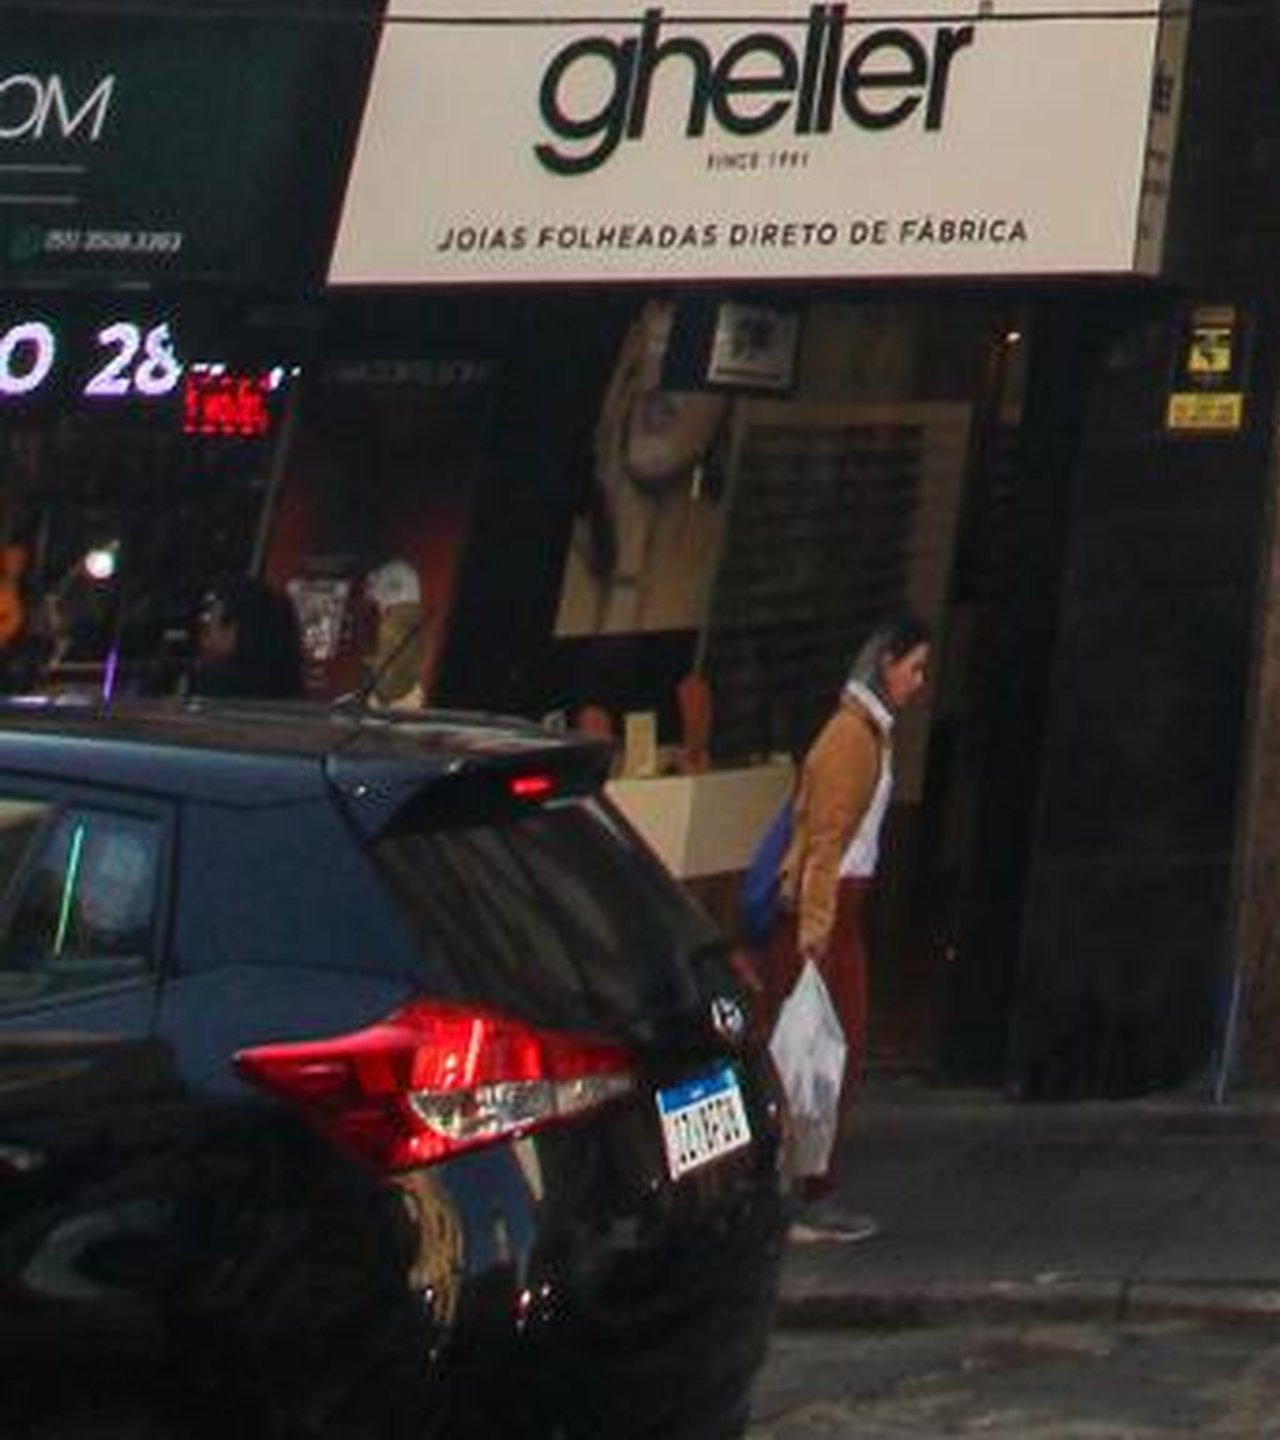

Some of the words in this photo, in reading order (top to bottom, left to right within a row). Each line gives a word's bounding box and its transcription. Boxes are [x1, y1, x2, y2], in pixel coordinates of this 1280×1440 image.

[532, 3, 974, 177] gheller
[437, 226, 529, 252] JOIAS
[538, 223, 720, 249] FOLHEADAS
[729, 221, 839, 247] DIRETO
[849, 220, 889, 246] DE
